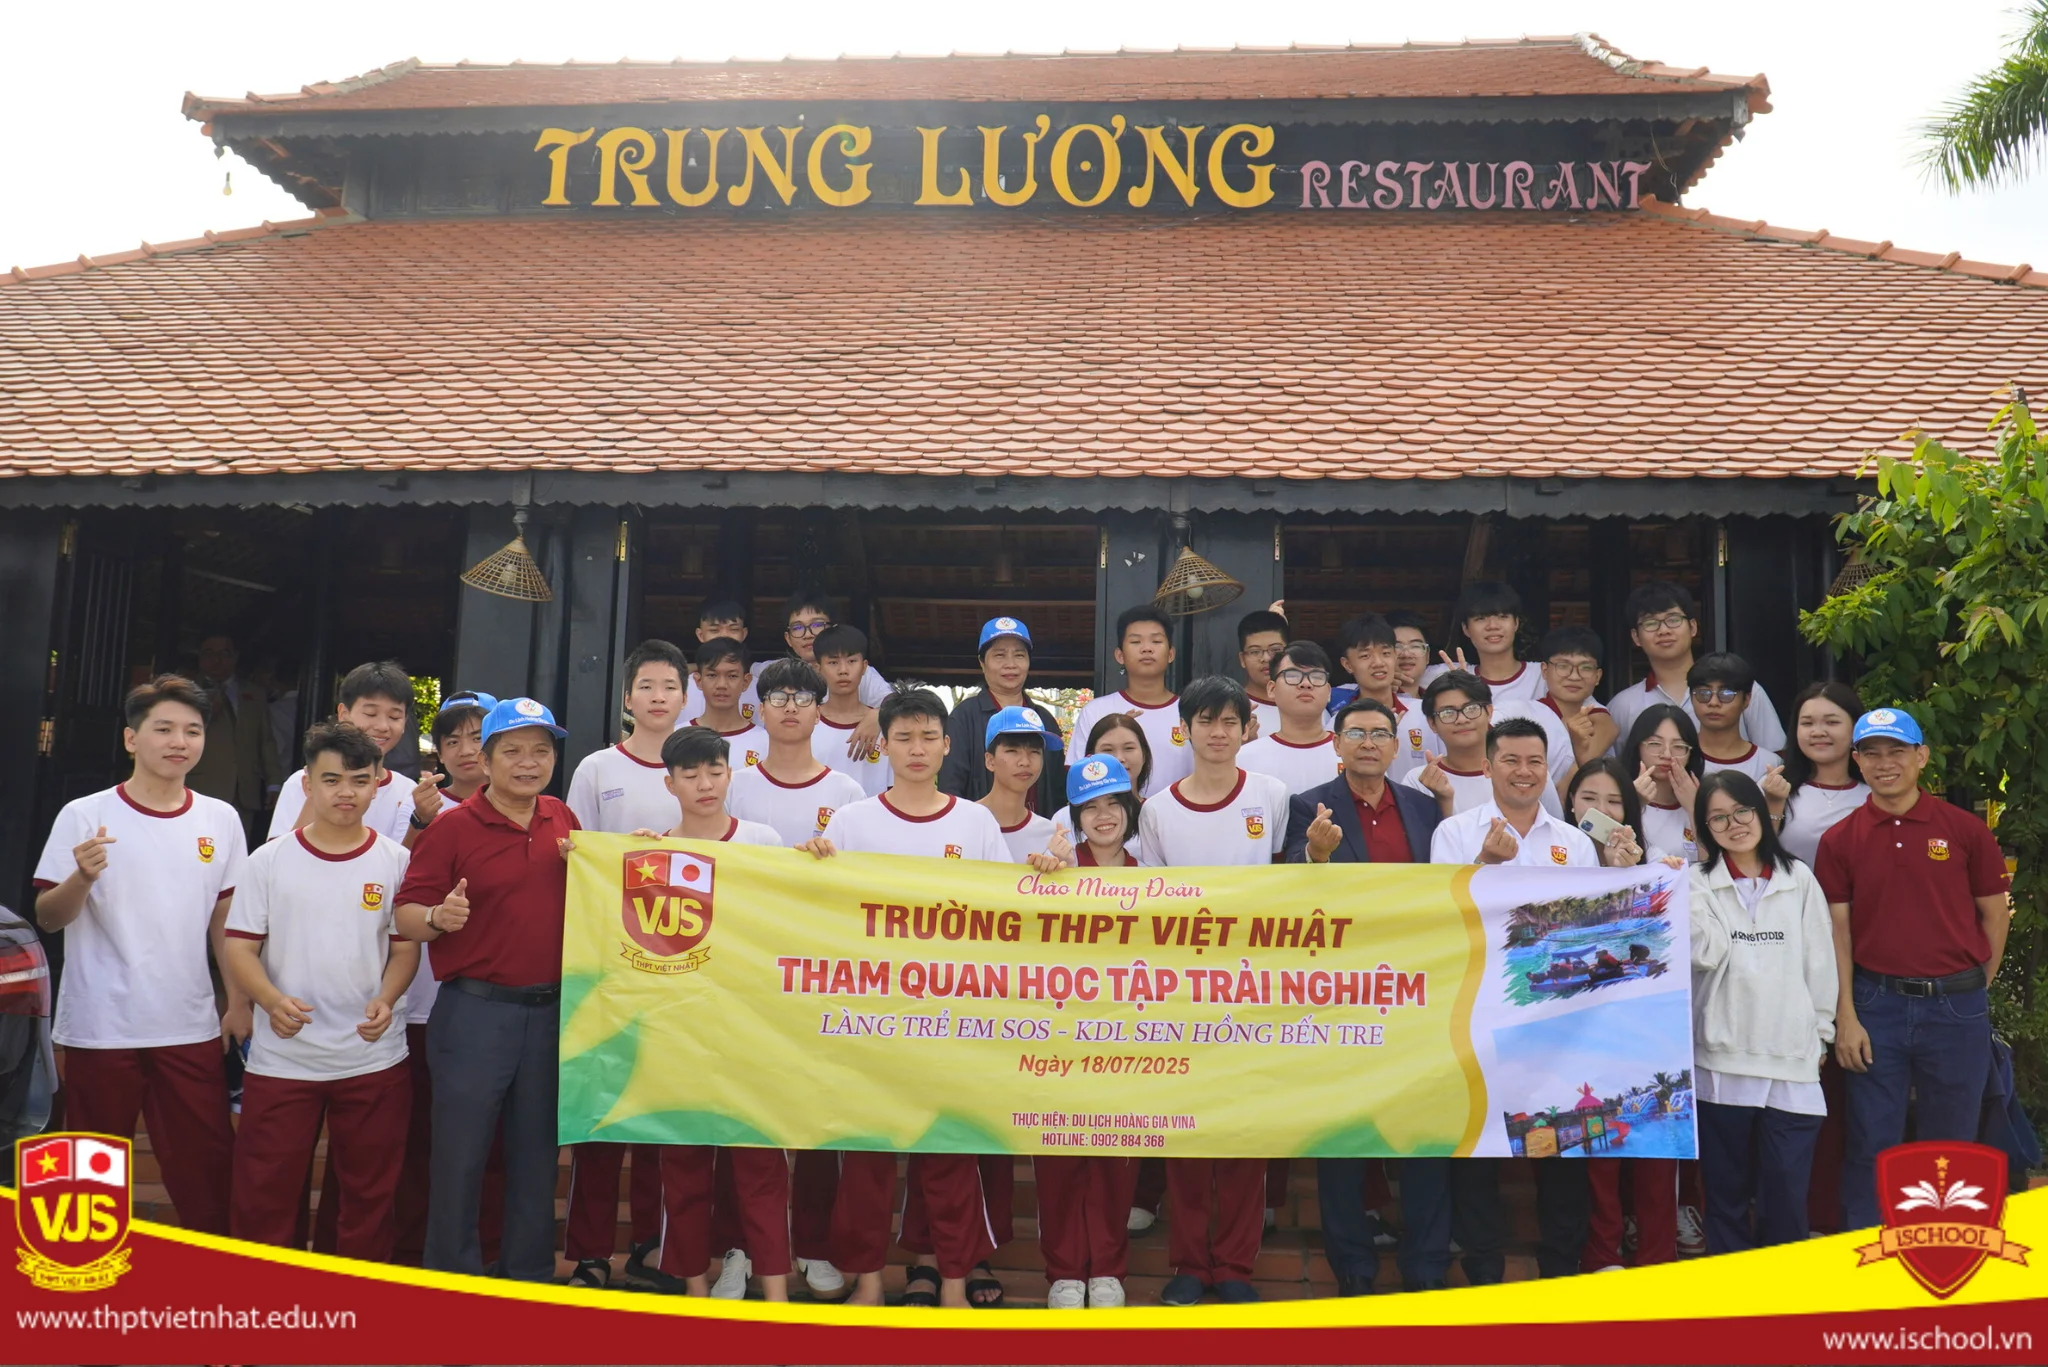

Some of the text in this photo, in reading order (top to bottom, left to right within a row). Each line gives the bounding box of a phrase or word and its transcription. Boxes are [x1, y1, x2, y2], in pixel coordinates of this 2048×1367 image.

[533, 114, 1276, 208] TRUNG LƯƠNG
[1300, 160, 1652, 210] RESTAURANT
[1017, 874, 1203, 910] Chào Mừng Đoàn
[632, 896, 704, 937] VJS
[860, 899, 1352, 957] TRƯỜNG THPT VIỆT NHẬT
[636, 960, 653, 970] THPT
[778, 957, 1426, 1016] THAM QUAN HỌC TẬP TRẢI NGHIỆM
[819, 1009, 896, 1037] LÀNG
[902, 1010, 949, 1038] TRẺ
[956, 1018, 996, 1039] EM
[1000, 1019, 1051, 1041] SOS
[1074, 1021, 1129, 1042] KDL
[1134, 1021, 1185, 1043] SEN
[1190, 1014, 1273, 1044] HỒNG
[1279, 1014, 1331, 1044] BẾN
[1338, 1024, 1384, 1045] TRE
[1018, 1054, 1190, 1077] Ngày 18/07/2025
[1012, 1111, 1196, 1130] THỰC HIỆN: DU LỊCH HOÀNG GIA VINA
[1042, 1133, 1165, 1148] HOTLINE: 0902 884 368
